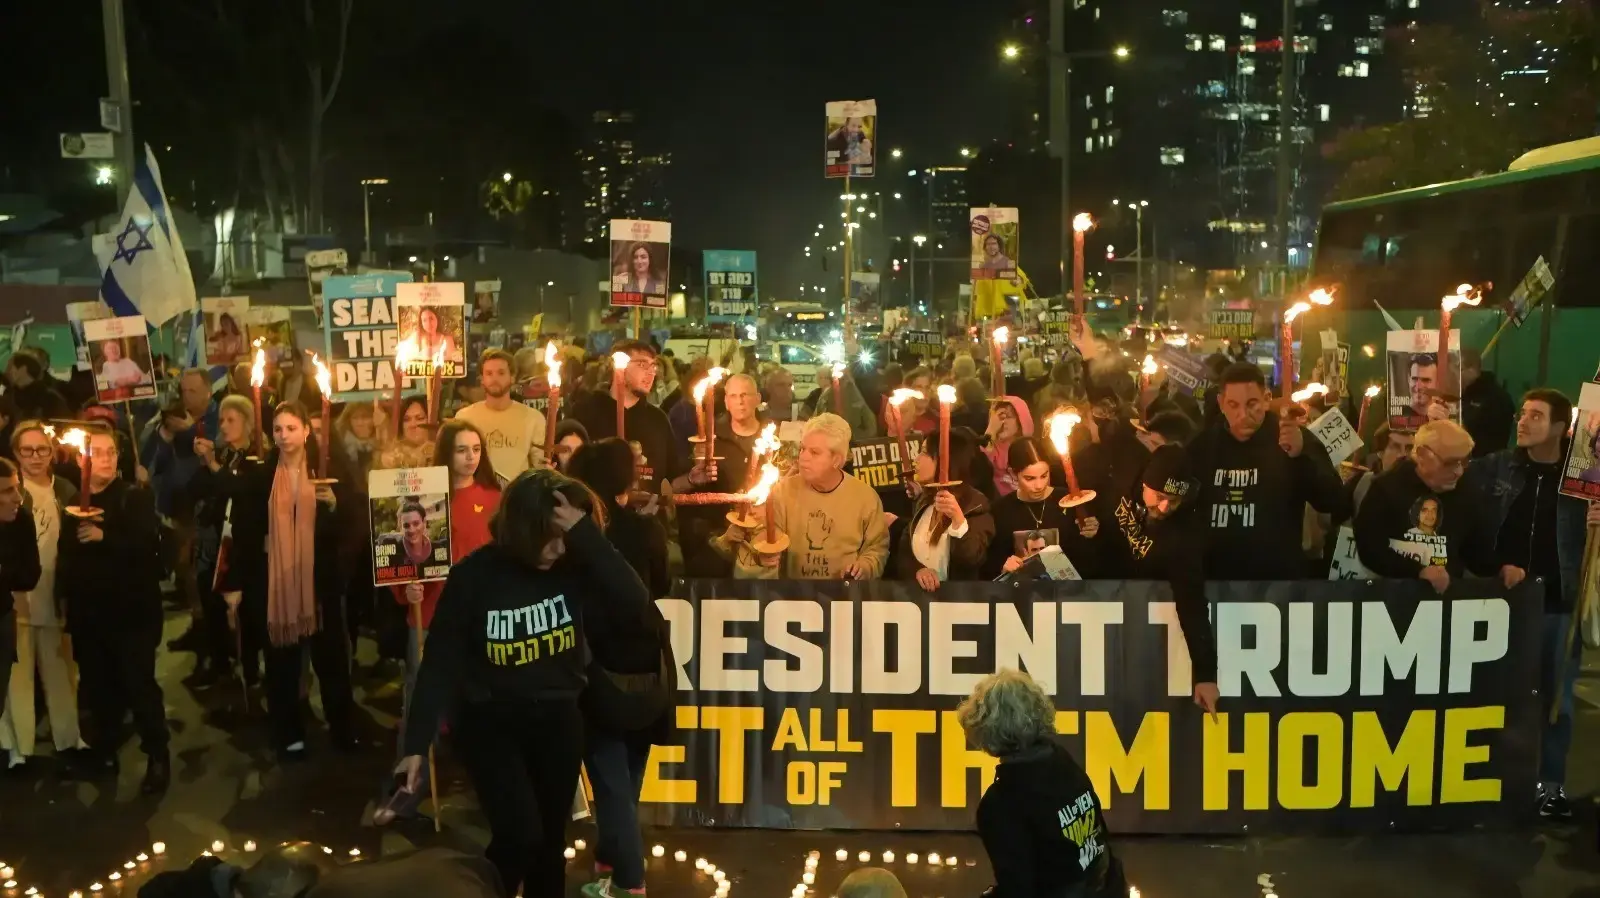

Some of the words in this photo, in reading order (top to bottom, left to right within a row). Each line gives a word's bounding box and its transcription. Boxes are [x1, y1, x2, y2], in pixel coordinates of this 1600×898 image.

[709, 272, 725, 285] דם
[728, 272, 751, 285] כמה
[343, 330, 398, 359] THE
[336, 360, 411, 392] DEA
[1391, 396, 1410, 406] BRING
[1391, 407, 1403, 415] HIM
[851, 444, 888, 467] בבית
[1568, 457, 1590, 469] BRING
[1566, 467, 1580, 479] HIM
[375, 544, 396, 556] BRING
[376, 556, 389, 567] HER
[376, 566, 397, 578] HOME
[487, 594, 573, 639] בלעדיהם
[542, 625, 575, 656] הלך
[654, 598, 1123, 696] RESIDENT
[1148, 598, 1510, 697] TRUMP
[772, 707, 863, 752] ALL
[639, 706, 763, 804] ET
[1202, 706, 1505, 811] HOME
[786, 761, 847, 806] OF
[1058, 805, 1076, 828] ALL
